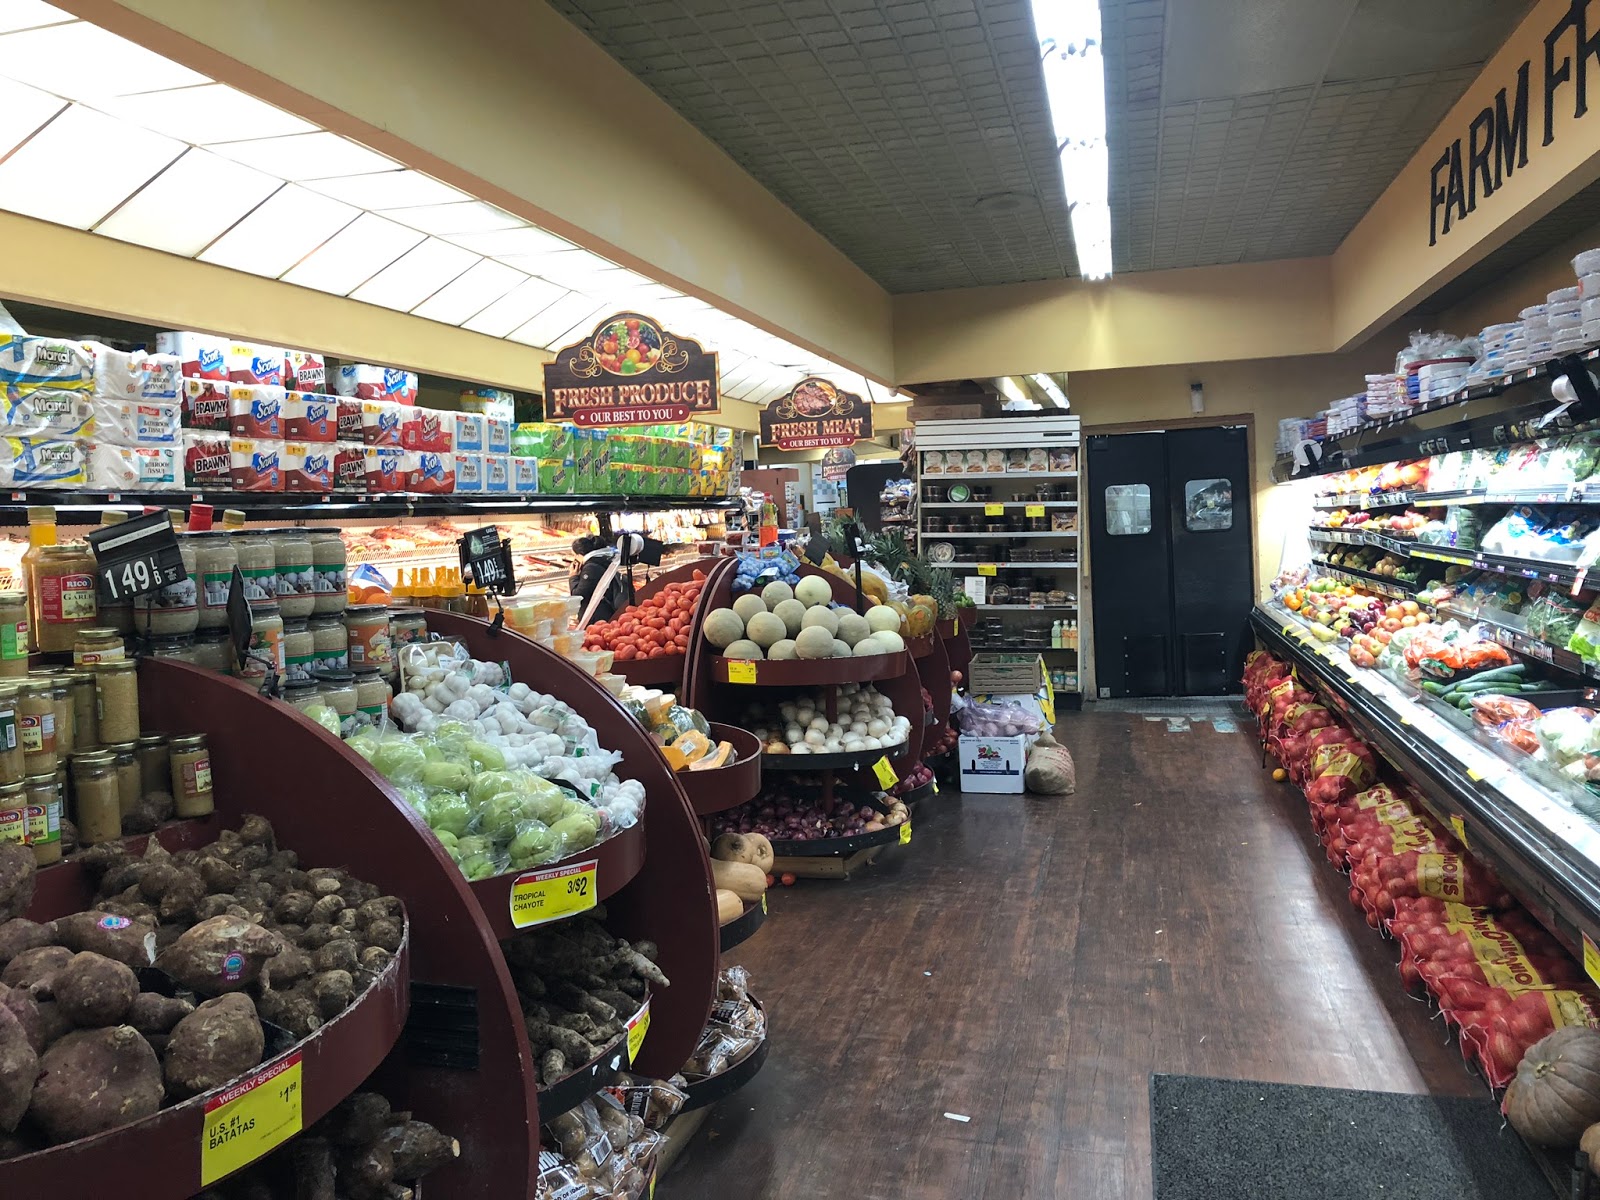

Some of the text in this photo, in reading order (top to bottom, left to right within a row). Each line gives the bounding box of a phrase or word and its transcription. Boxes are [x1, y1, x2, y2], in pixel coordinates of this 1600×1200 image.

[1429, 60, 1530, 246] FARM
[299, 368, 325, 382] BRAWNY
[552, 380, 712, 416] FRESH PRODUCE
[195, 400, 227, 415] BRAWNY
[256, 399, 278, 418] Scott
[309, 404, 326, 421] Scott
[590, 408, 673, 423] OUR BEST TO YOU
[770, 417, 863, 442] FRESH MEAT
[789, 440, 804, 448] OUR
[829, 437, 844, 445] YOU
[195, 455, 230, 472] BRAWNY
[256, 452, 277, 472] Scott
[307, 454, 326, 472] Scott
[104, 560, 150, 599] 1.49
[535, 866, 582, 881] WEEKLY SPECIAL
[514, 890, 546, 902] TROPICAL
[513, 900, 544, 911] CHAYOTE
[218, 1061, 291, 1104] WEEKLY SPECIAL
[630, 1091, 643, 1115] OTATOES
[209, 1115, 241, 1138] U.S. #1
[209, 1118, 256, 1150] BATATAS
